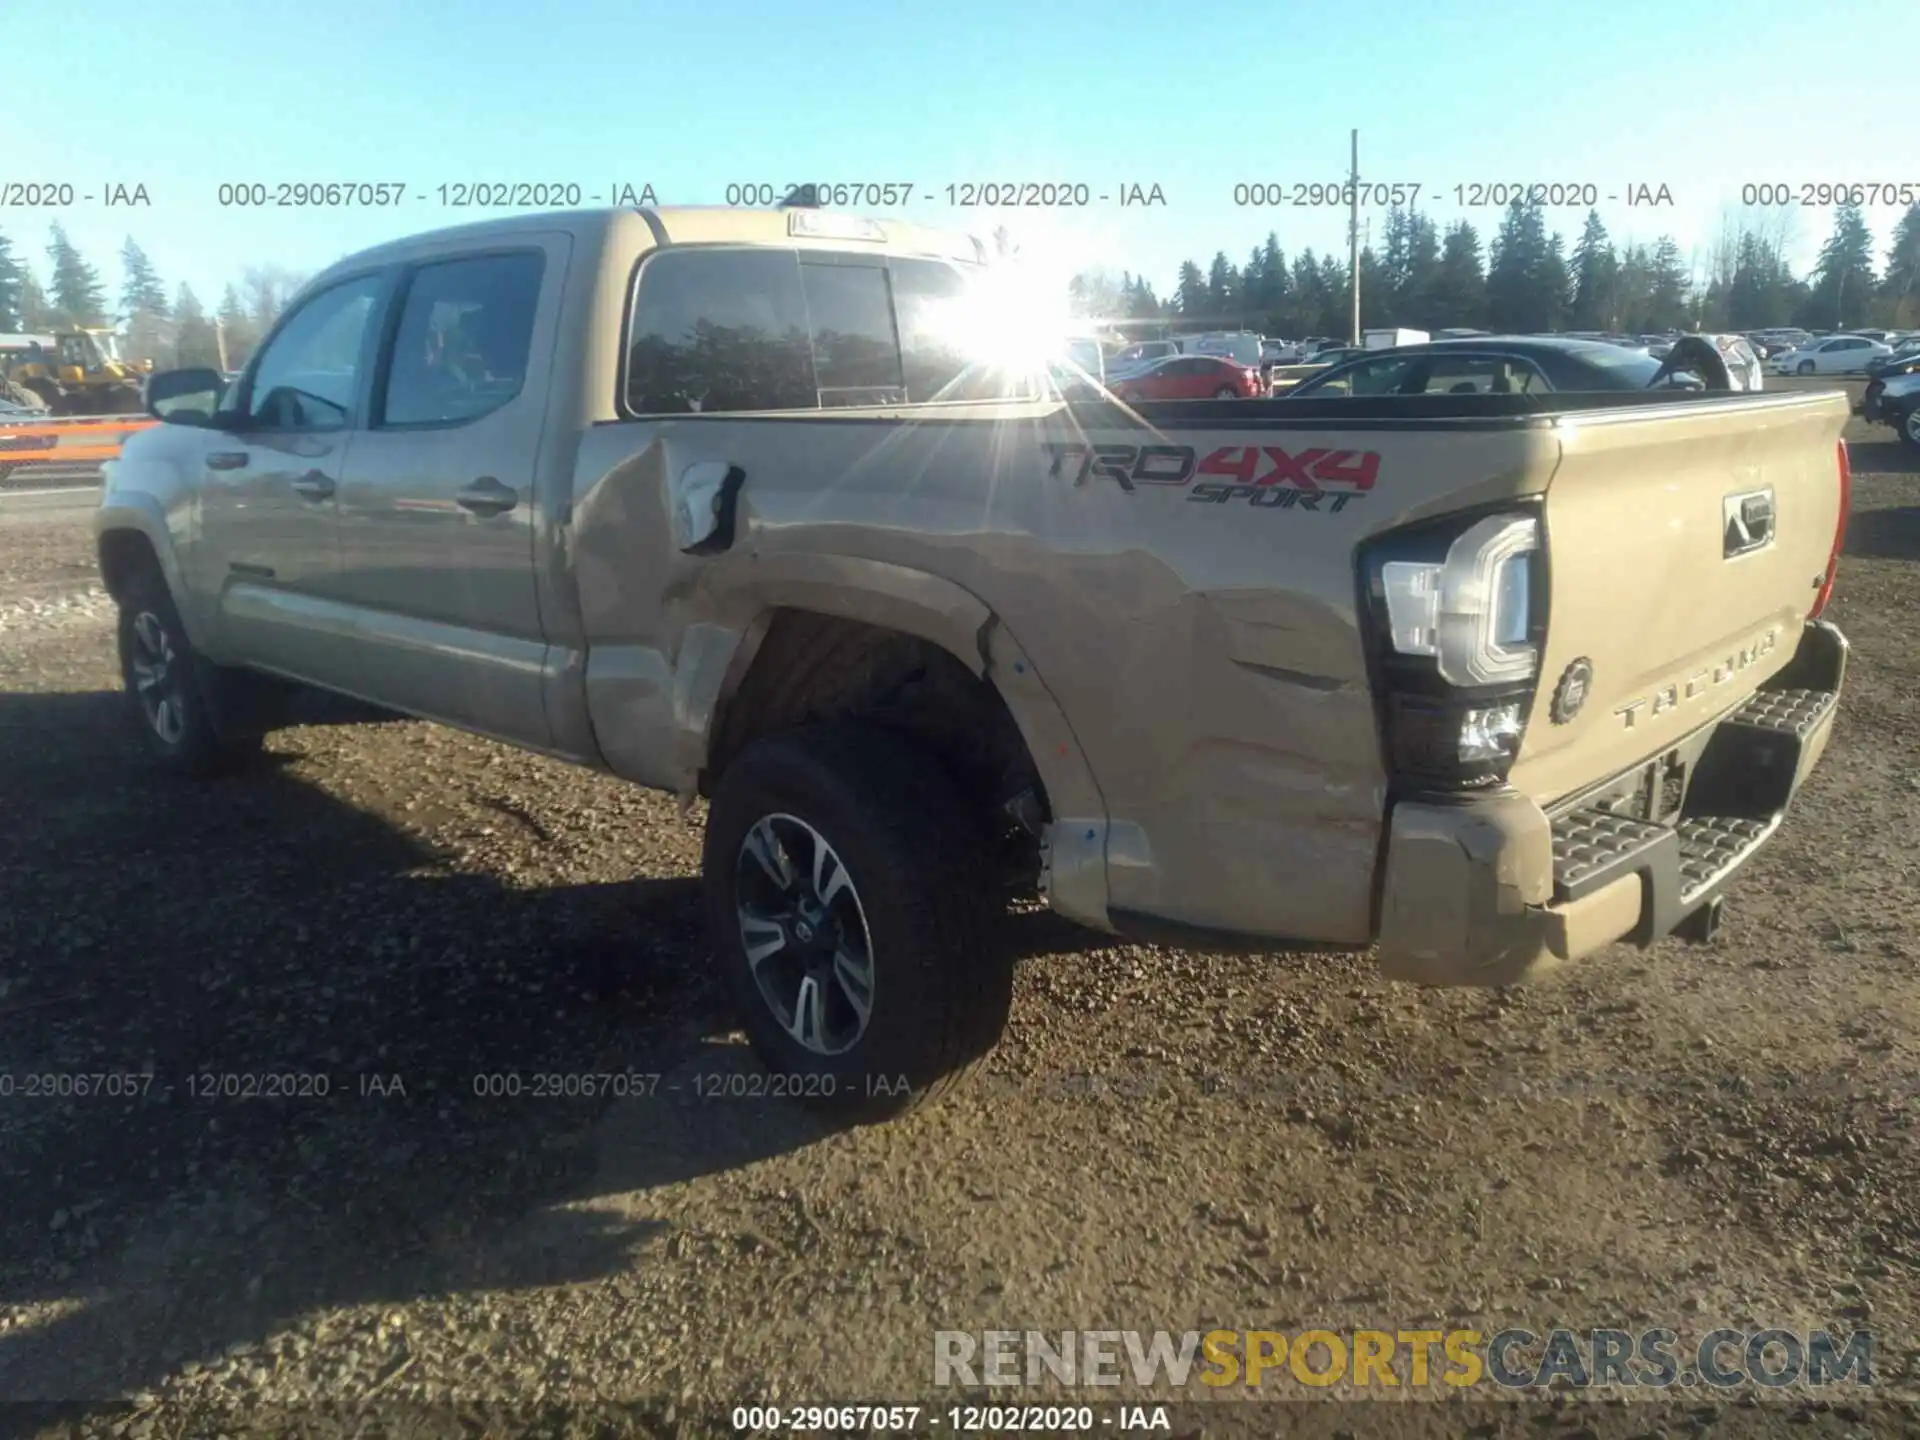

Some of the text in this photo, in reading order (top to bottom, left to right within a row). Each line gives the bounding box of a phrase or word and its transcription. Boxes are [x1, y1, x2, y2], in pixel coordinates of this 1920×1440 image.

[1042, 443, 1196, 496] TRD
[1185, 483, 1368, 515] SPORT
[1613, 628, 1780, 731] TACOMA
